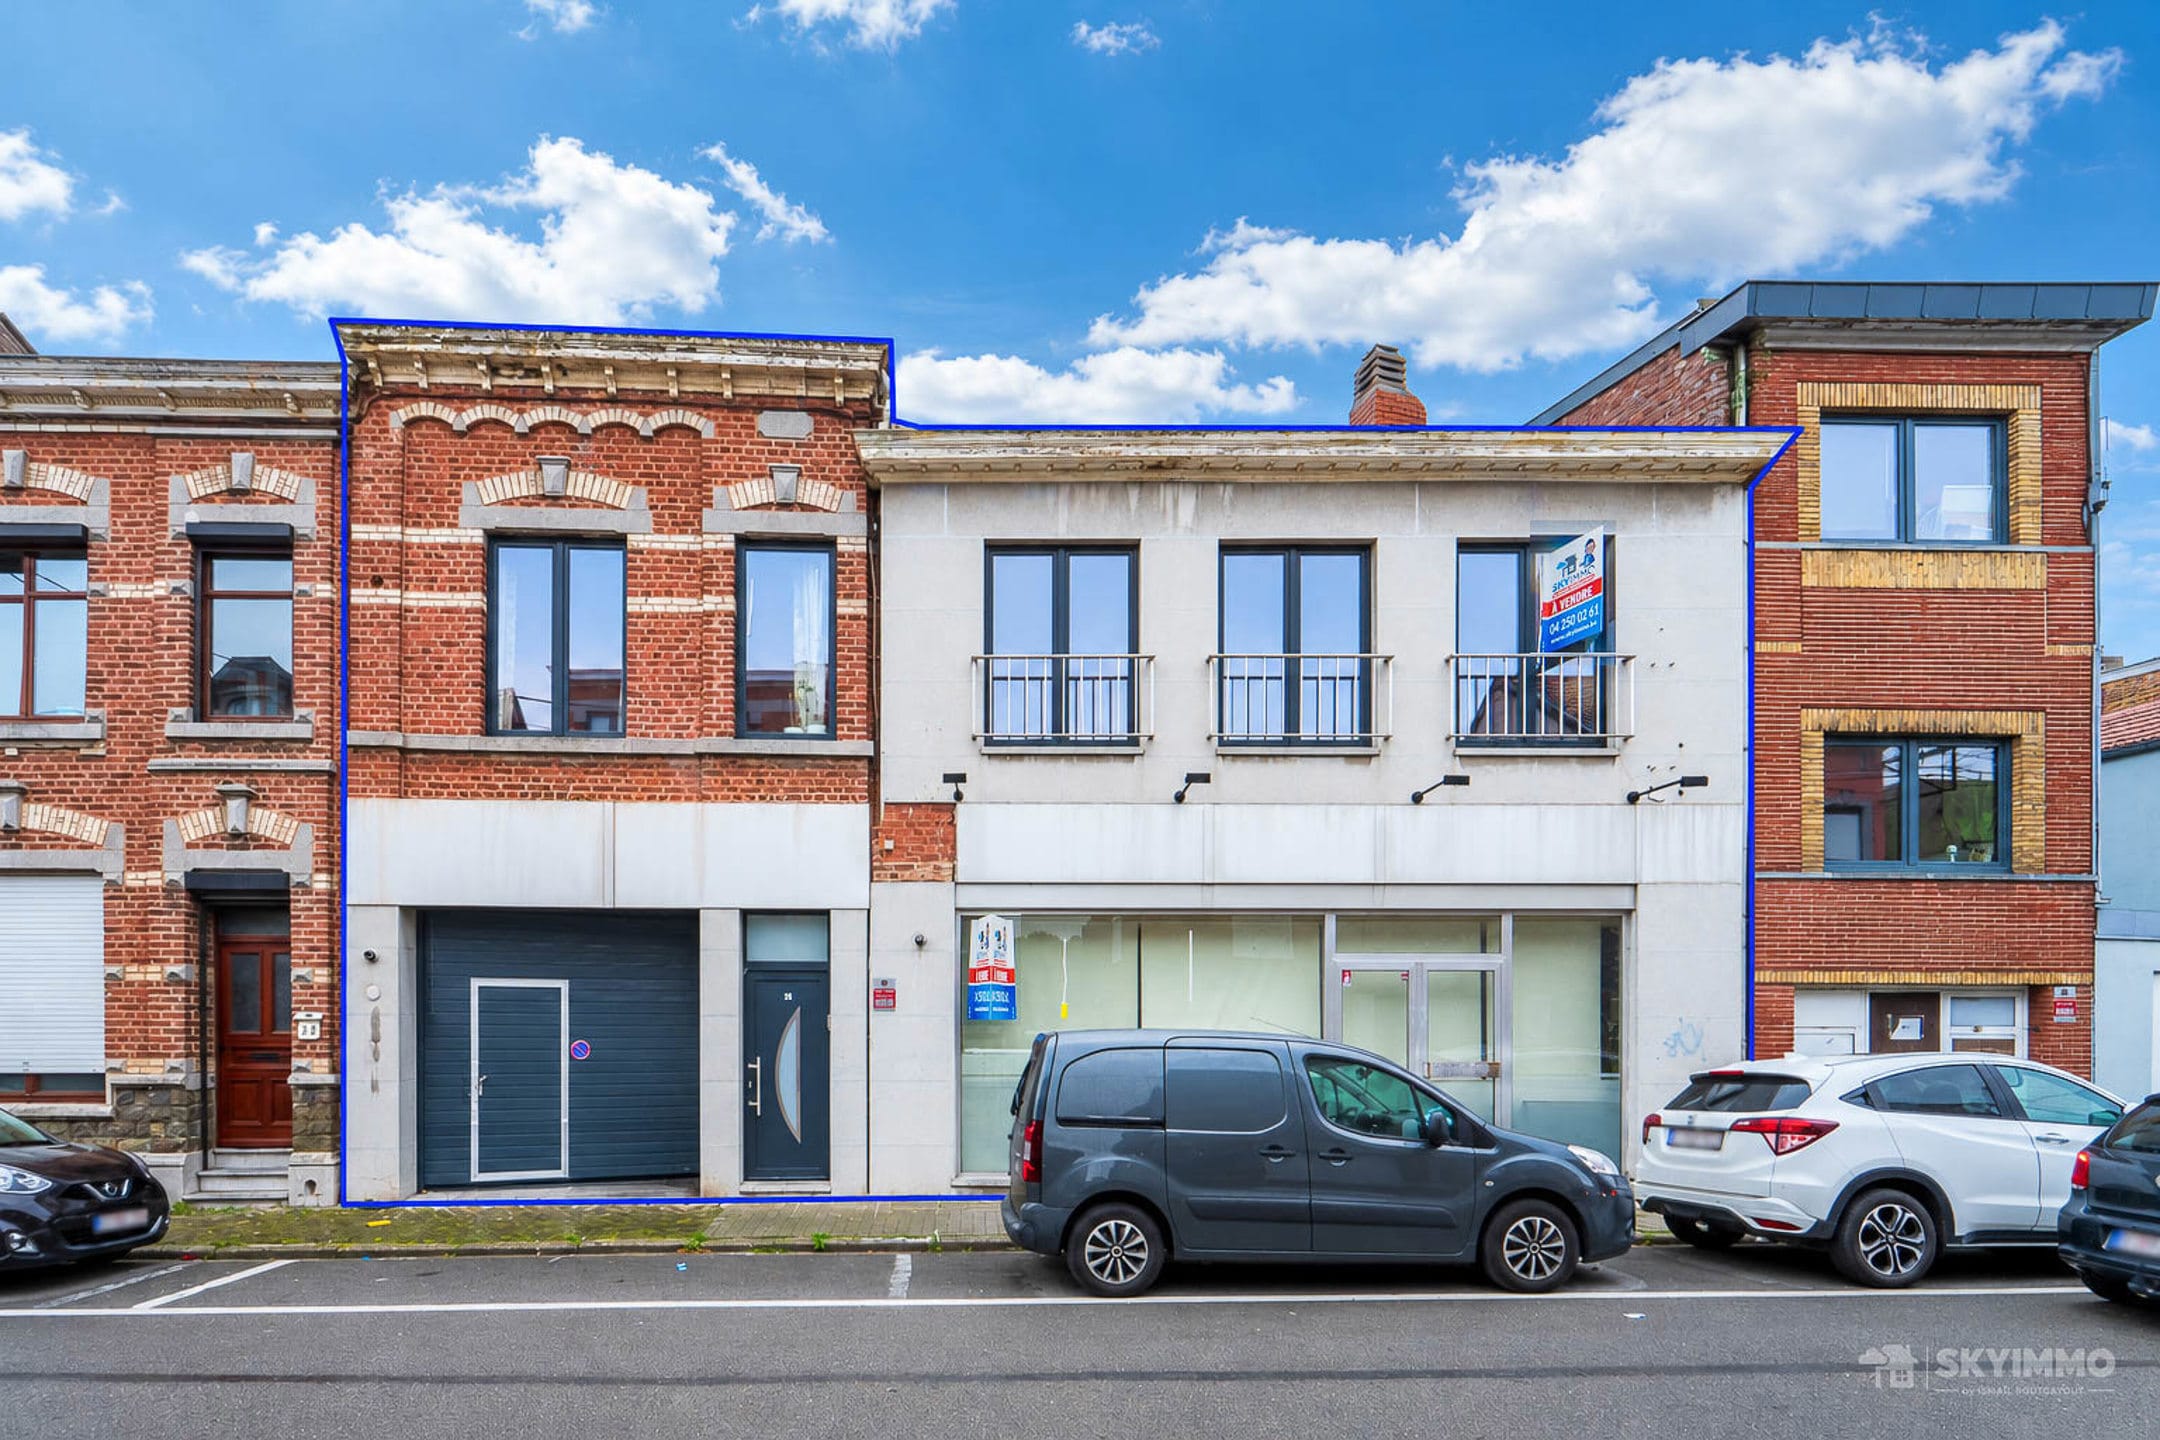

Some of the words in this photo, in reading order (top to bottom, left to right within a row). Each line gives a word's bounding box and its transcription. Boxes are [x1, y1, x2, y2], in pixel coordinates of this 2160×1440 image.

[1560, 584, 1593, 611] VENDRE
[1549, 621, 1559, 635] 04
[1561, 614, 1576, 631] 250
[1577, 608, 1588, 623] 02
[1588, 603, 1599, 618] 61
